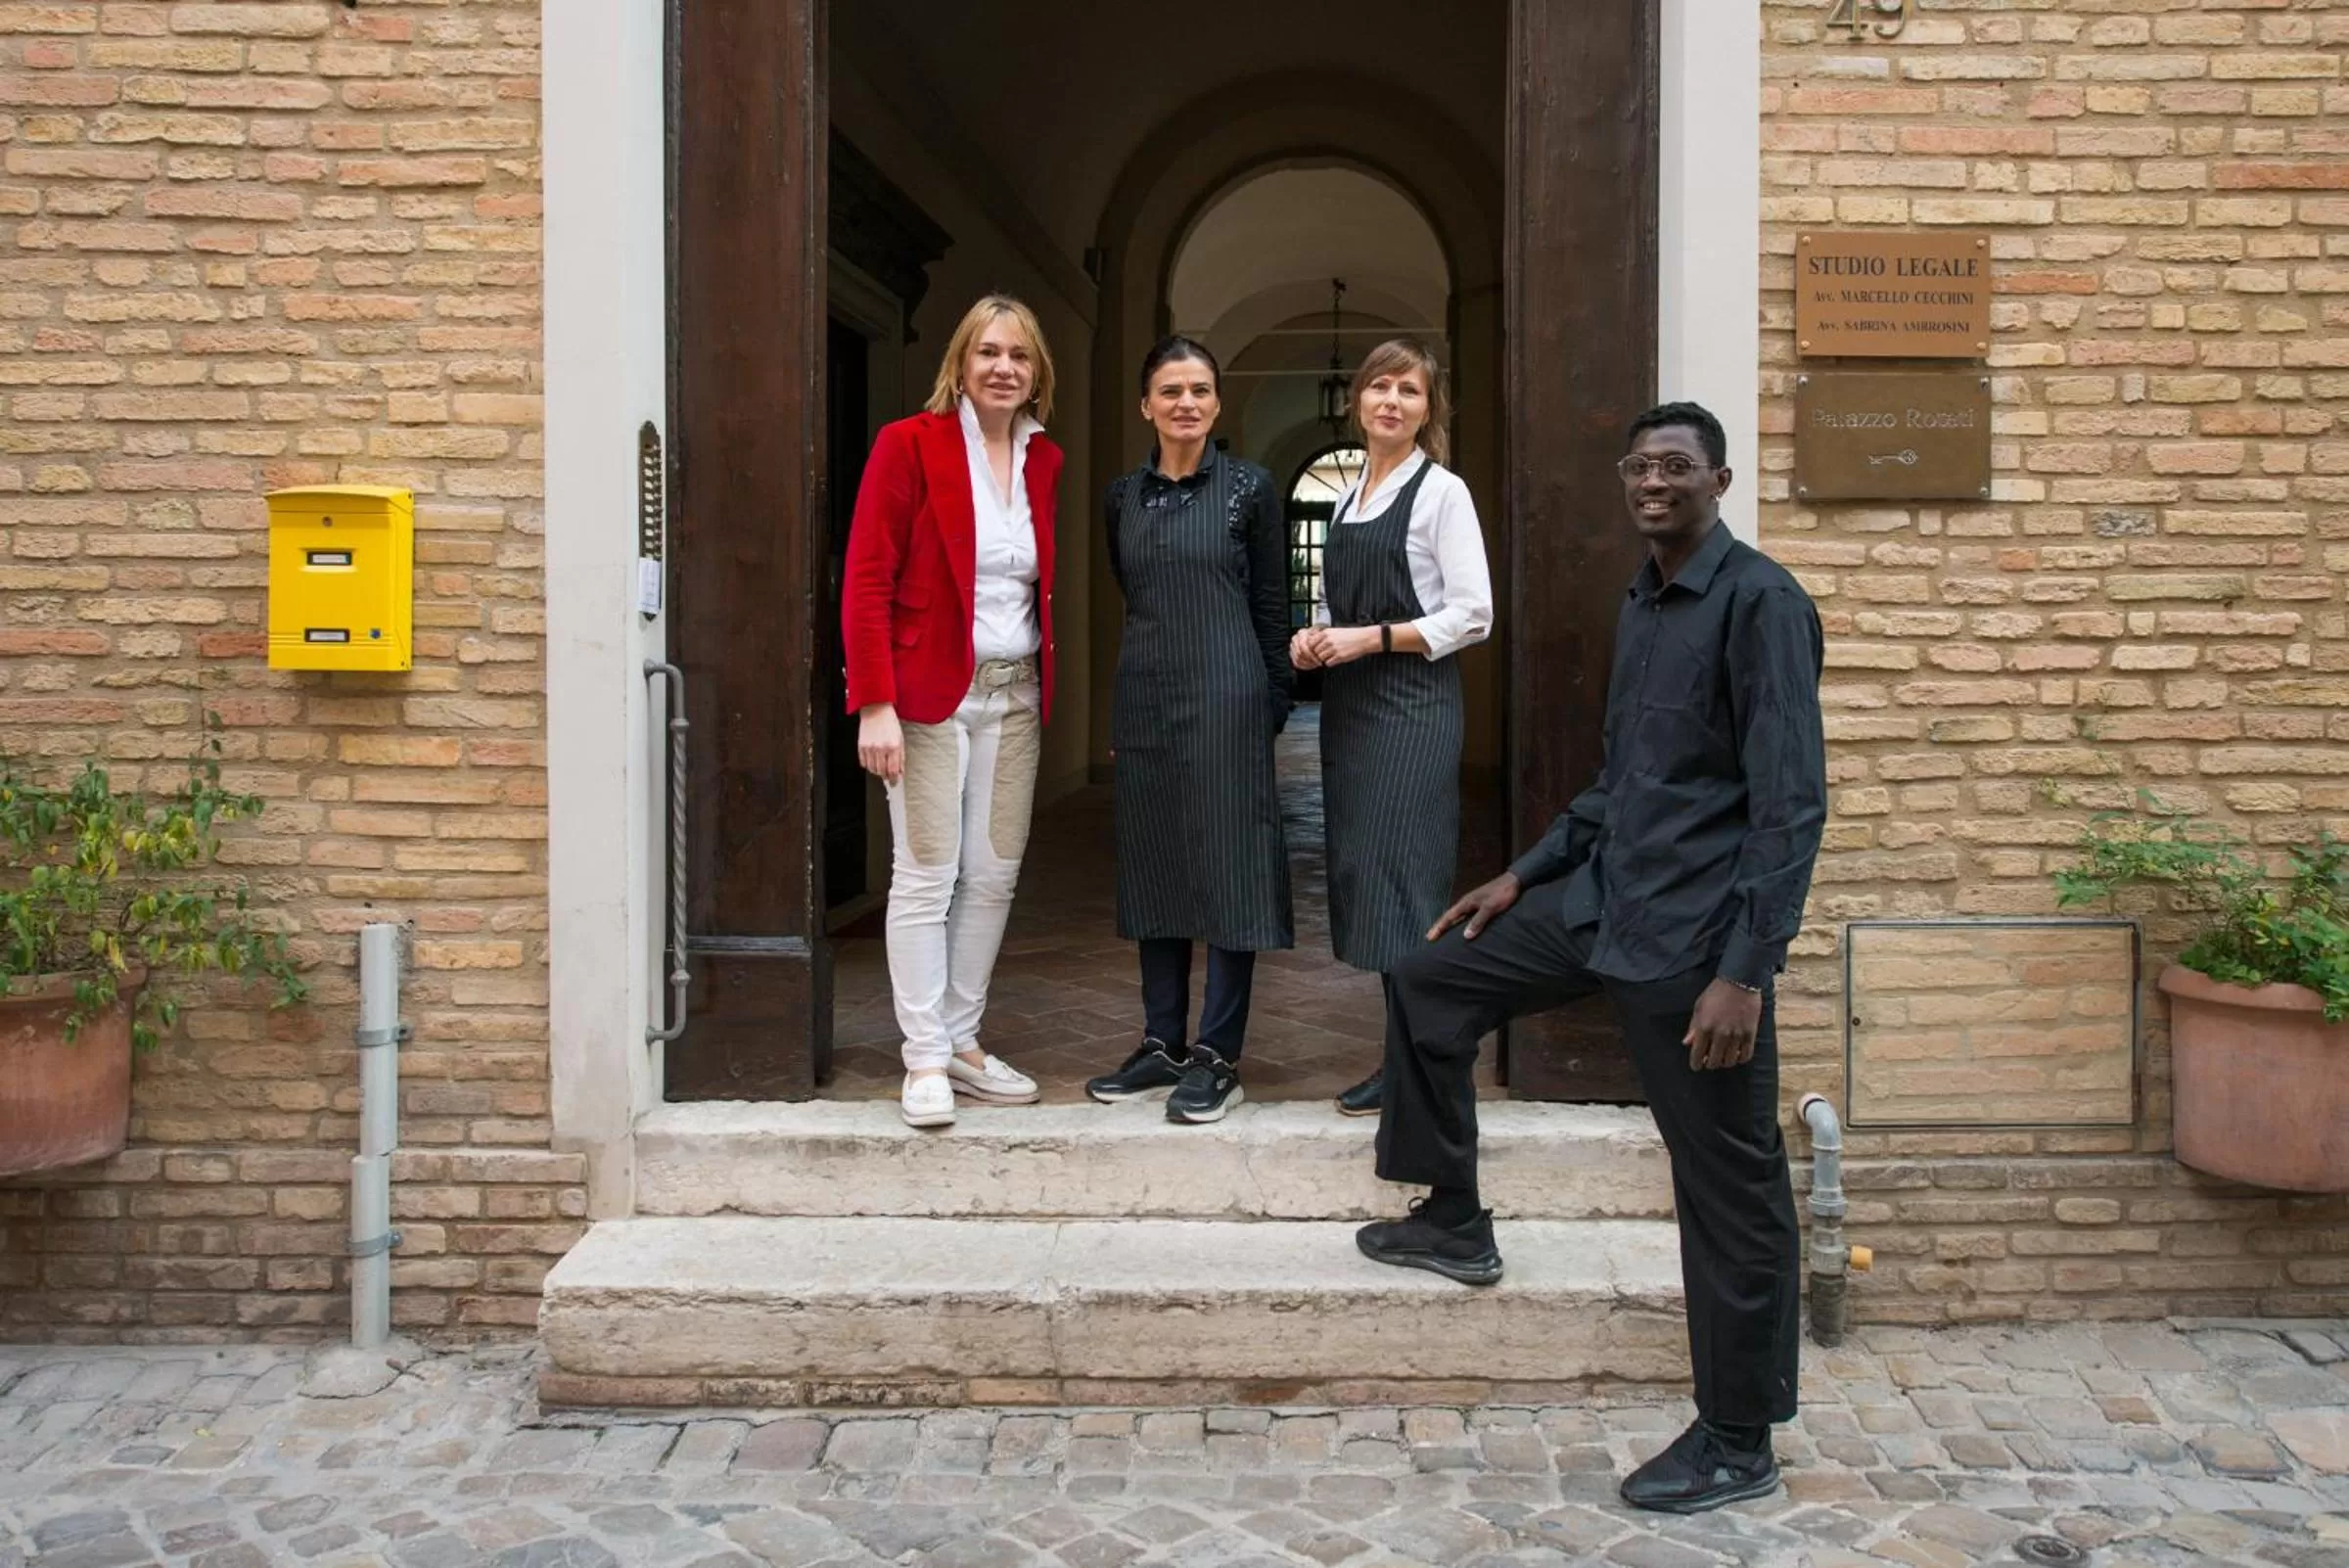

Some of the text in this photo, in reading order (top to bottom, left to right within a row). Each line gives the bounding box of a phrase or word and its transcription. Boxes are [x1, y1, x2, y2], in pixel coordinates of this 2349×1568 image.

[1809, 255, 1979, 277] STUDIO LEGALE
[1841, 290, 1909, 303] MARCELLO
[1914, 292, 1974, 305] CECCHINI
[1844, 320, 1897, 333] SABRINA
[1903, 321, 1970, 334] AMBROSINI
[1813, 407, 1897, 429] Palazzo
